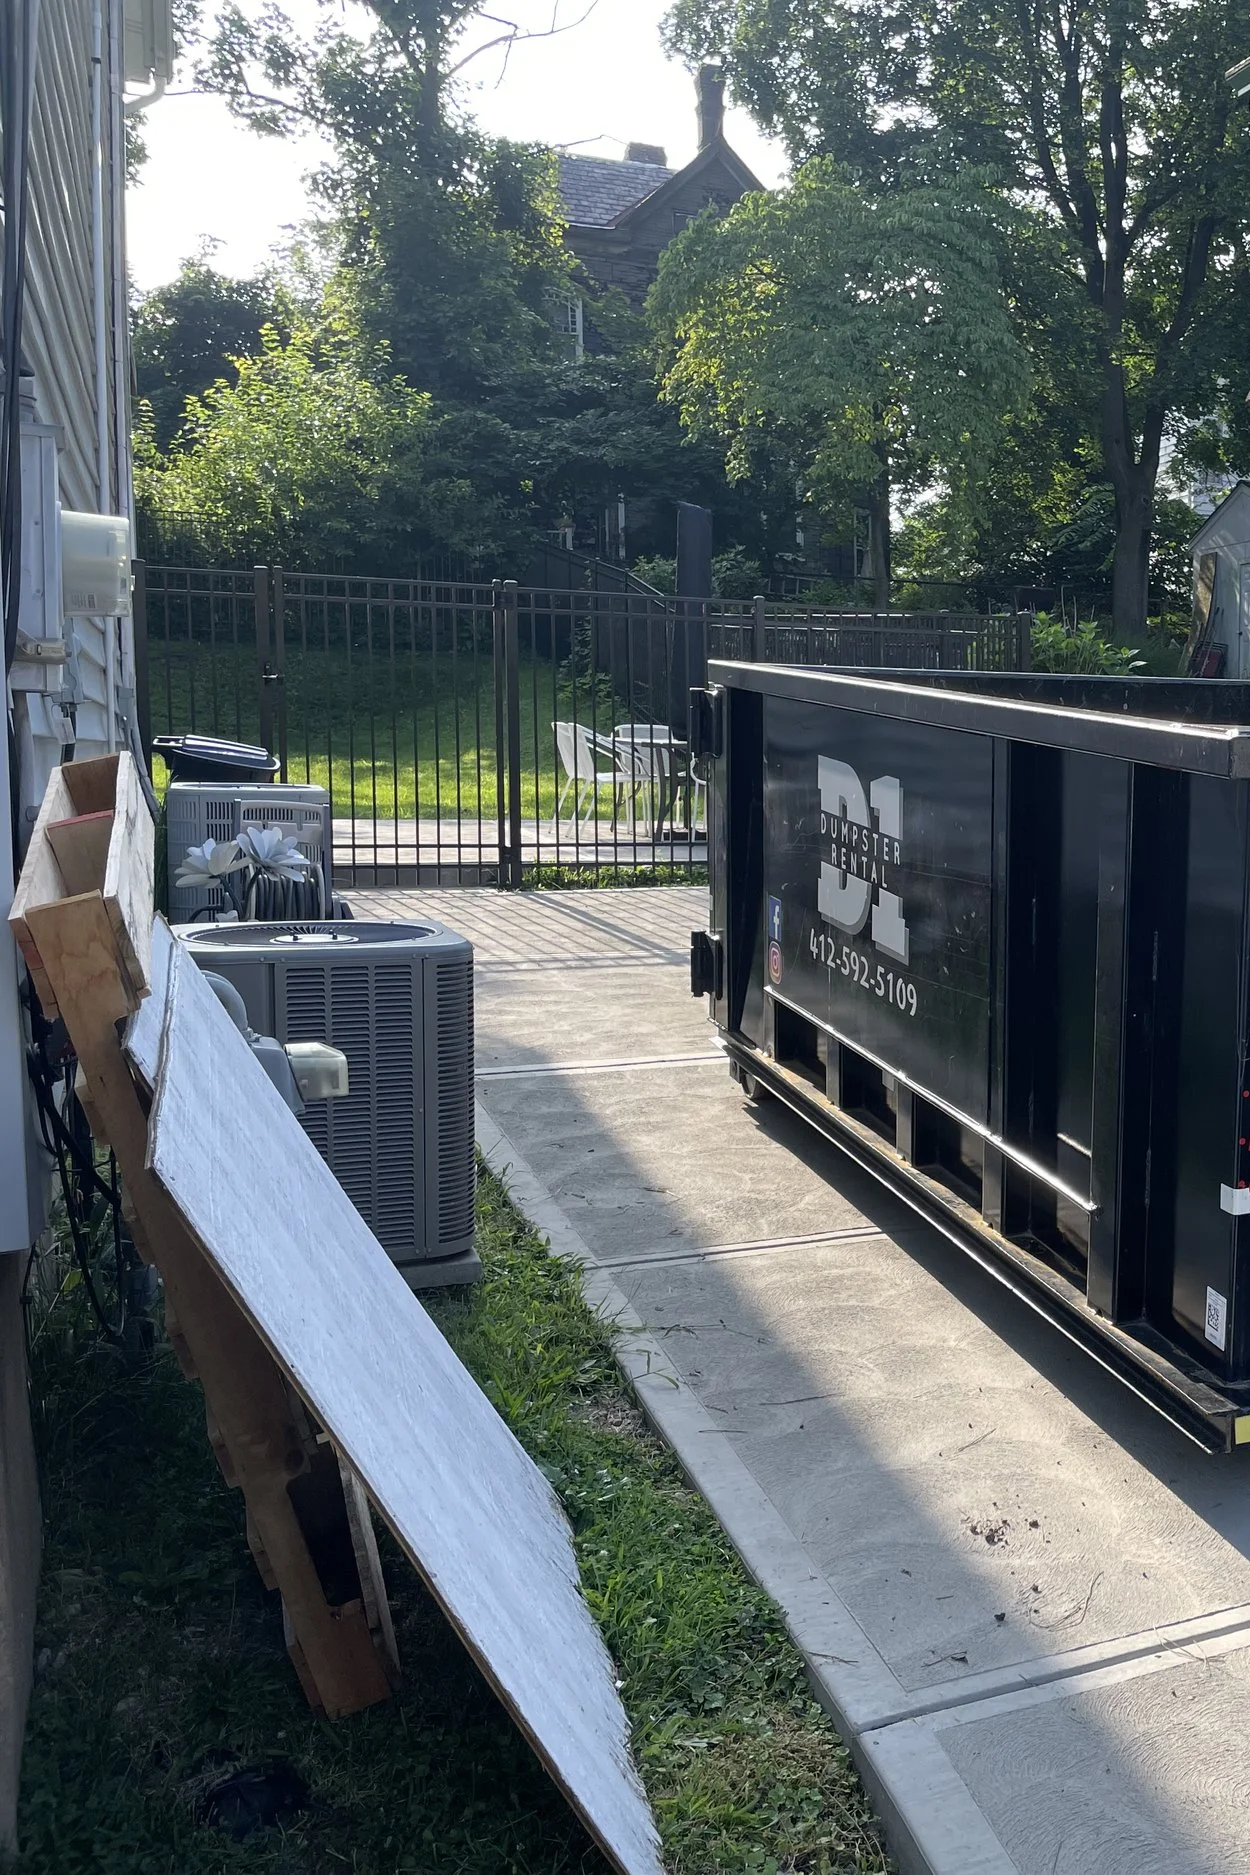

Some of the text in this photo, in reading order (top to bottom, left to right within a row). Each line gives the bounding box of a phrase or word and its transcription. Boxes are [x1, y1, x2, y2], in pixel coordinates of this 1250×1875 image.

[820, 813, 901, 866] DUMPSTER
[831, 843, 888, 888] RENTAL
[809, 928, 918, 1016] 412-592-5109
